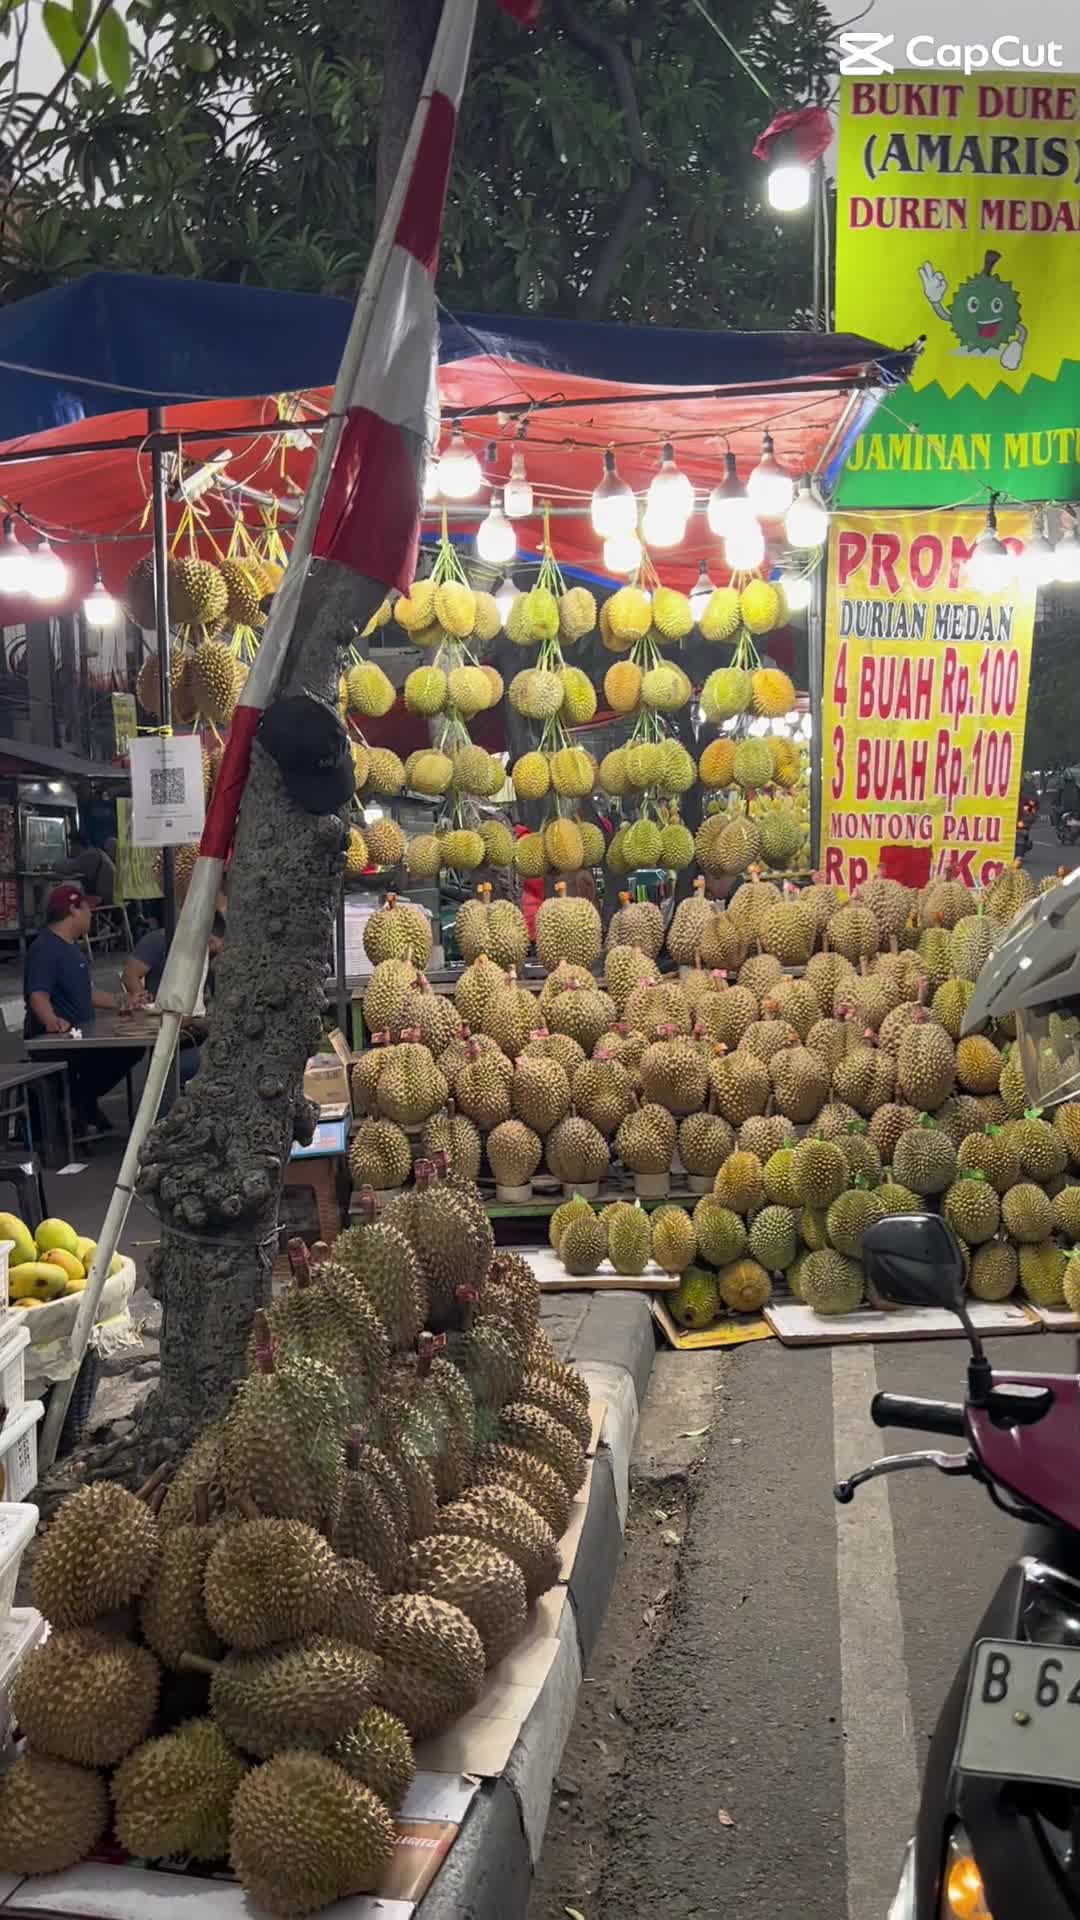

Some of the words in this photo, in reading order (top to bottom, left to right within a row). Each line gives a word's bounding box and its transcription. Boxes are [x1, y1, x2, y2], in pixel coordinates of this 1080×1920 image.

[852, 83, 963, 117] BUKIT
[850, 197, 968, 229] DUREN
[980, 199, 1080, 232] MEDA
[847, 433, 991, 471] JAMINAN
[1003, 427, 1080, 470] MUT
[838, 531, 1024, 594] PROM
[840, 600, 927, 639] DURIAN
[933, 604, 1014, 641] MEDAN
[833, 643, 848, 718] 4
[859, 656, 935, 720] BUAH
[940, 647, 1019, 731] Rp.100
[831, 725, 845, 799] 3
[856, 739, 928, 801] BUAH
[934, 729, 1012, 811] Rp.100
[831, 813, 932, 840] MONTONG
[943, 815, 1001, 842] PALU
[825, 846, 869, 895] Rp
[982, 1652, 1011, 1704] B
